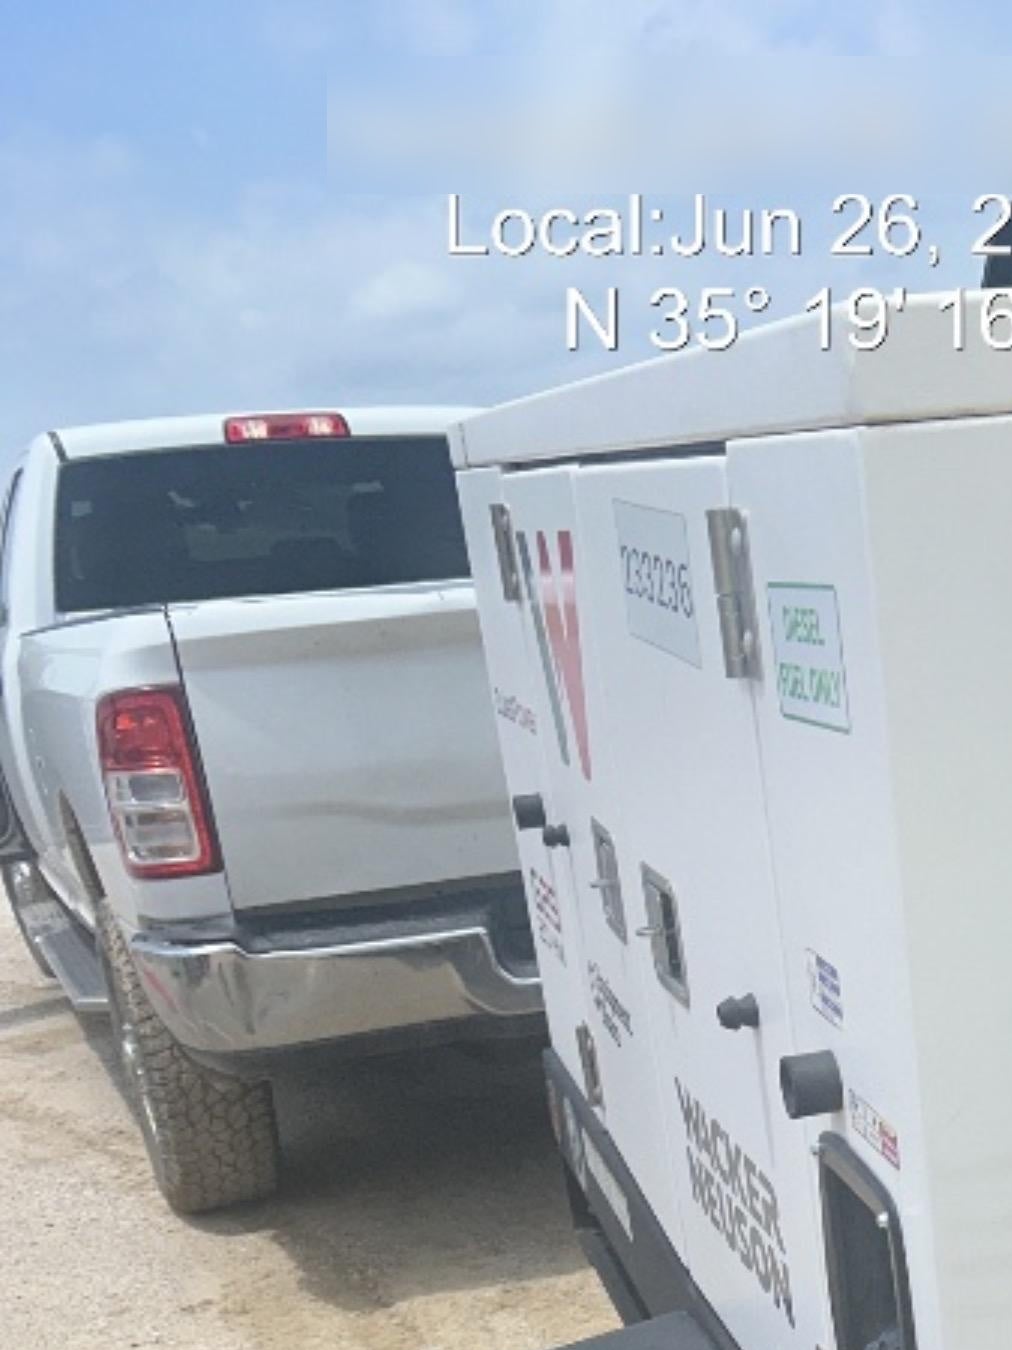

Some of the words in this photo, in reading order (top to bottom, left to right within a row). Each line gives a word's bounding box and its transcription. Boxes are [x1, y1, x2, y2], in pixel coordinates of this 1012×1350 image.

[620, 545, 695, 618] 233236
[674, 1076, 787, 1256] WACKER
[686, 1144, 796, 1330] NEUSON
